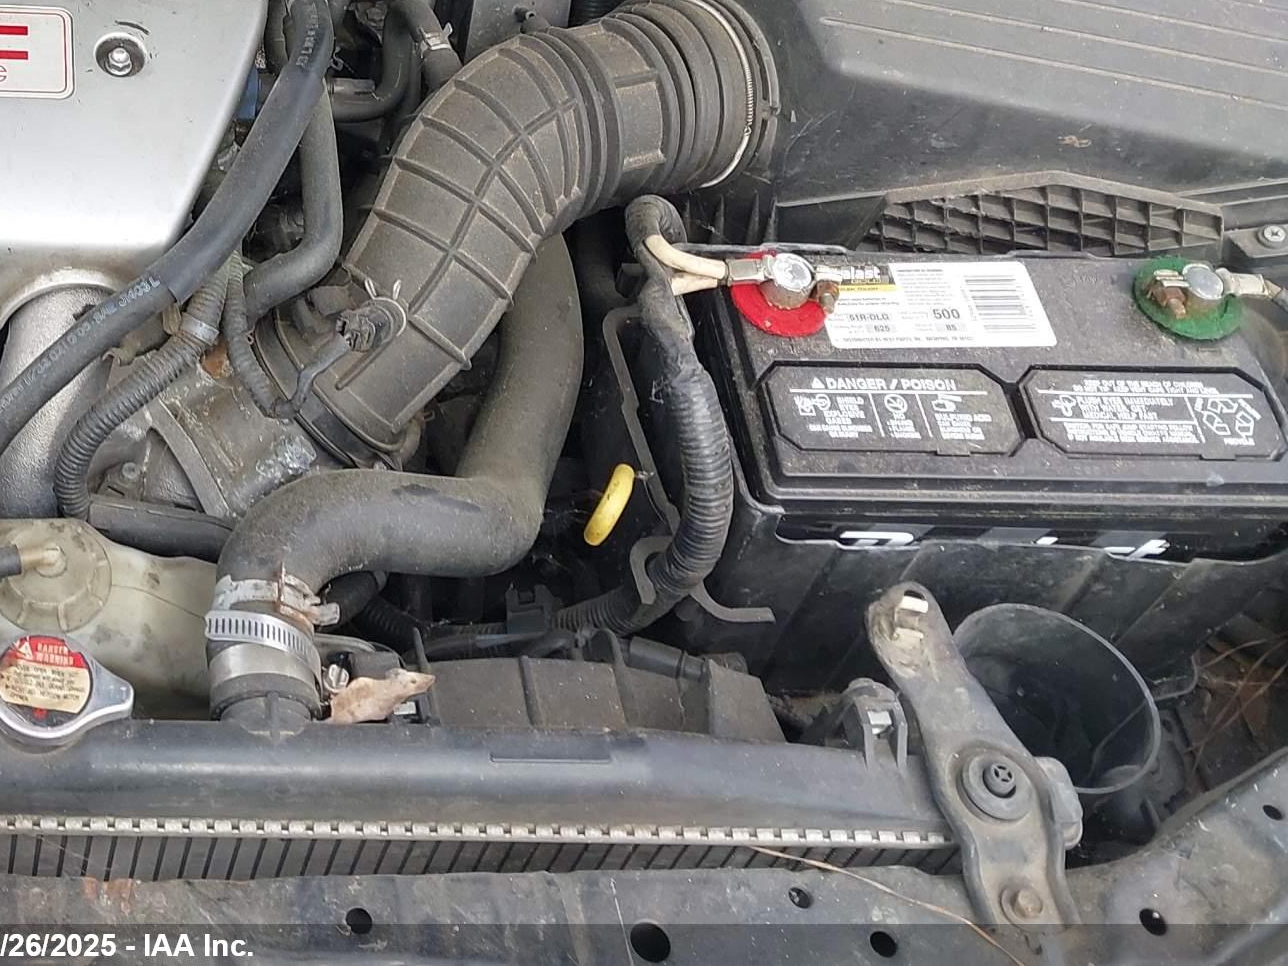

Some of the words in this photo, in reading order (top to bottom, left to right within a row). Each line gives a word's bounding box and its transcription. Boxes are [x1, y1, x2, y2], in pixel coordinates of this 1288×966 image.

[933, 308, 960, 319] 500
[873, 324, 890, 332] 625
[825, 377, 888, 390] DANGER
[889, 378, 898, 390] /
[900, 378, 957, 391] POISON
